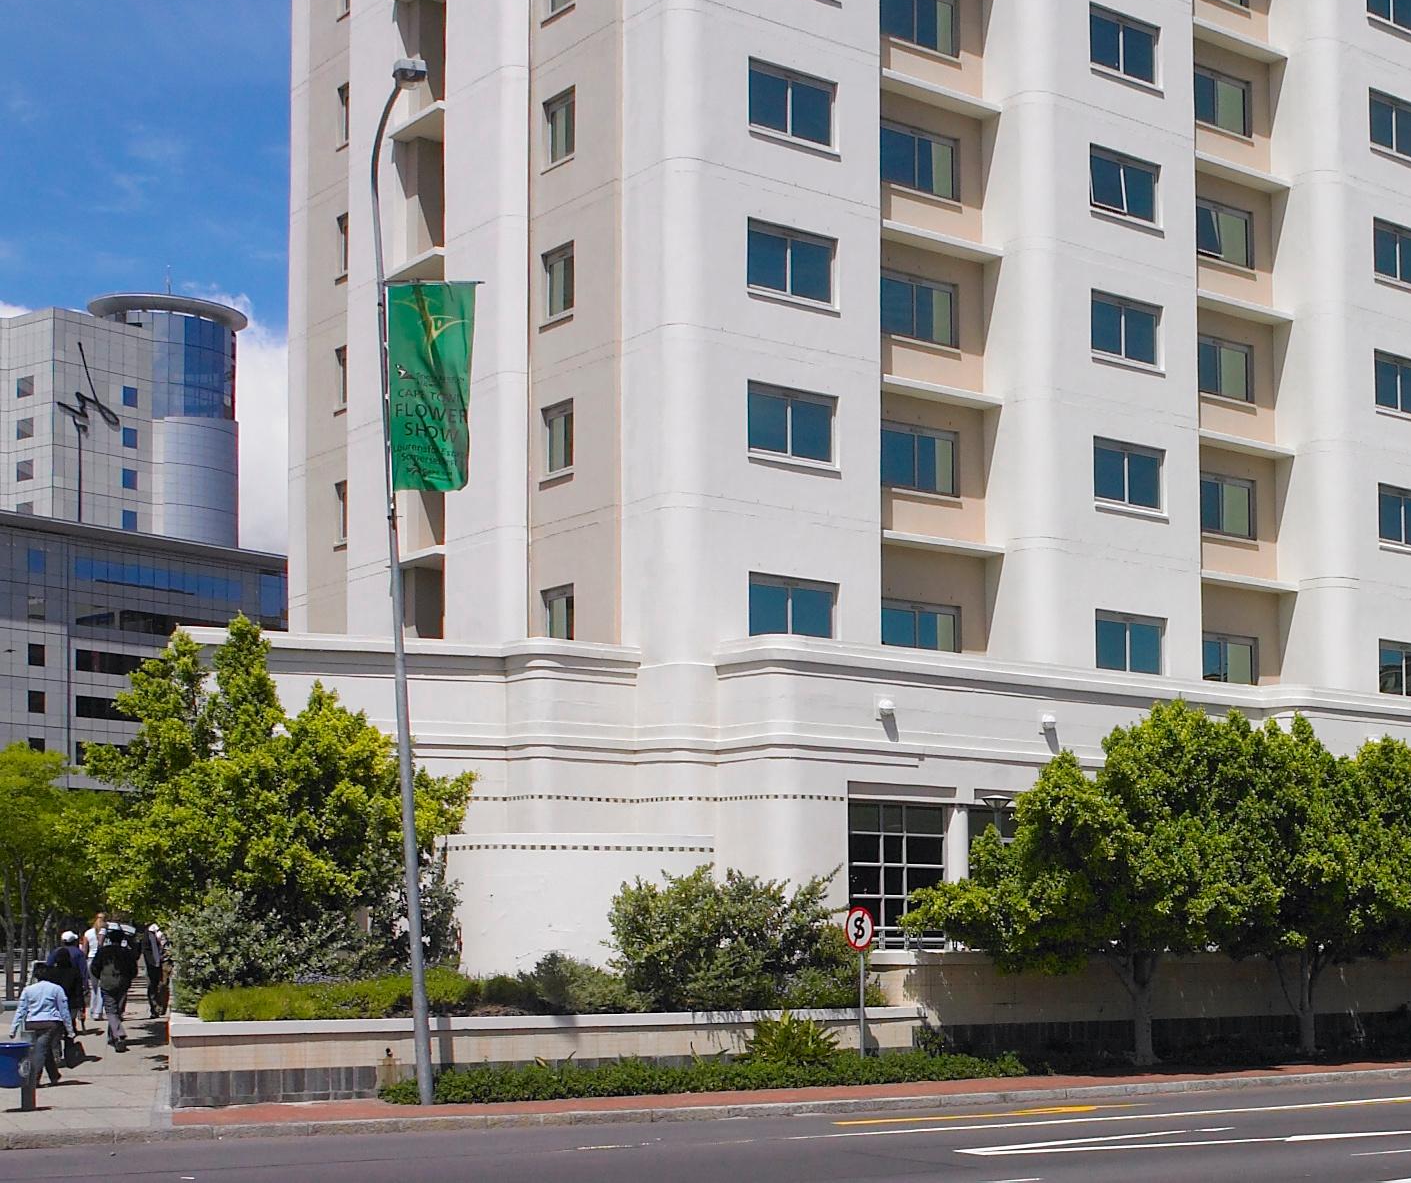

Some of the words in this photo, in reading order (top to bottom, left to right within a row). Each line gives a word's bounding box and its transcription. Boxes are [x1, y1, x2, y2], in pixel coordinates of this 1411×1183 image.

[395, 404, 465, 423] FLOWER
[405, 422, 458, 442] SHOW
[854, 917, 865, 939] S
